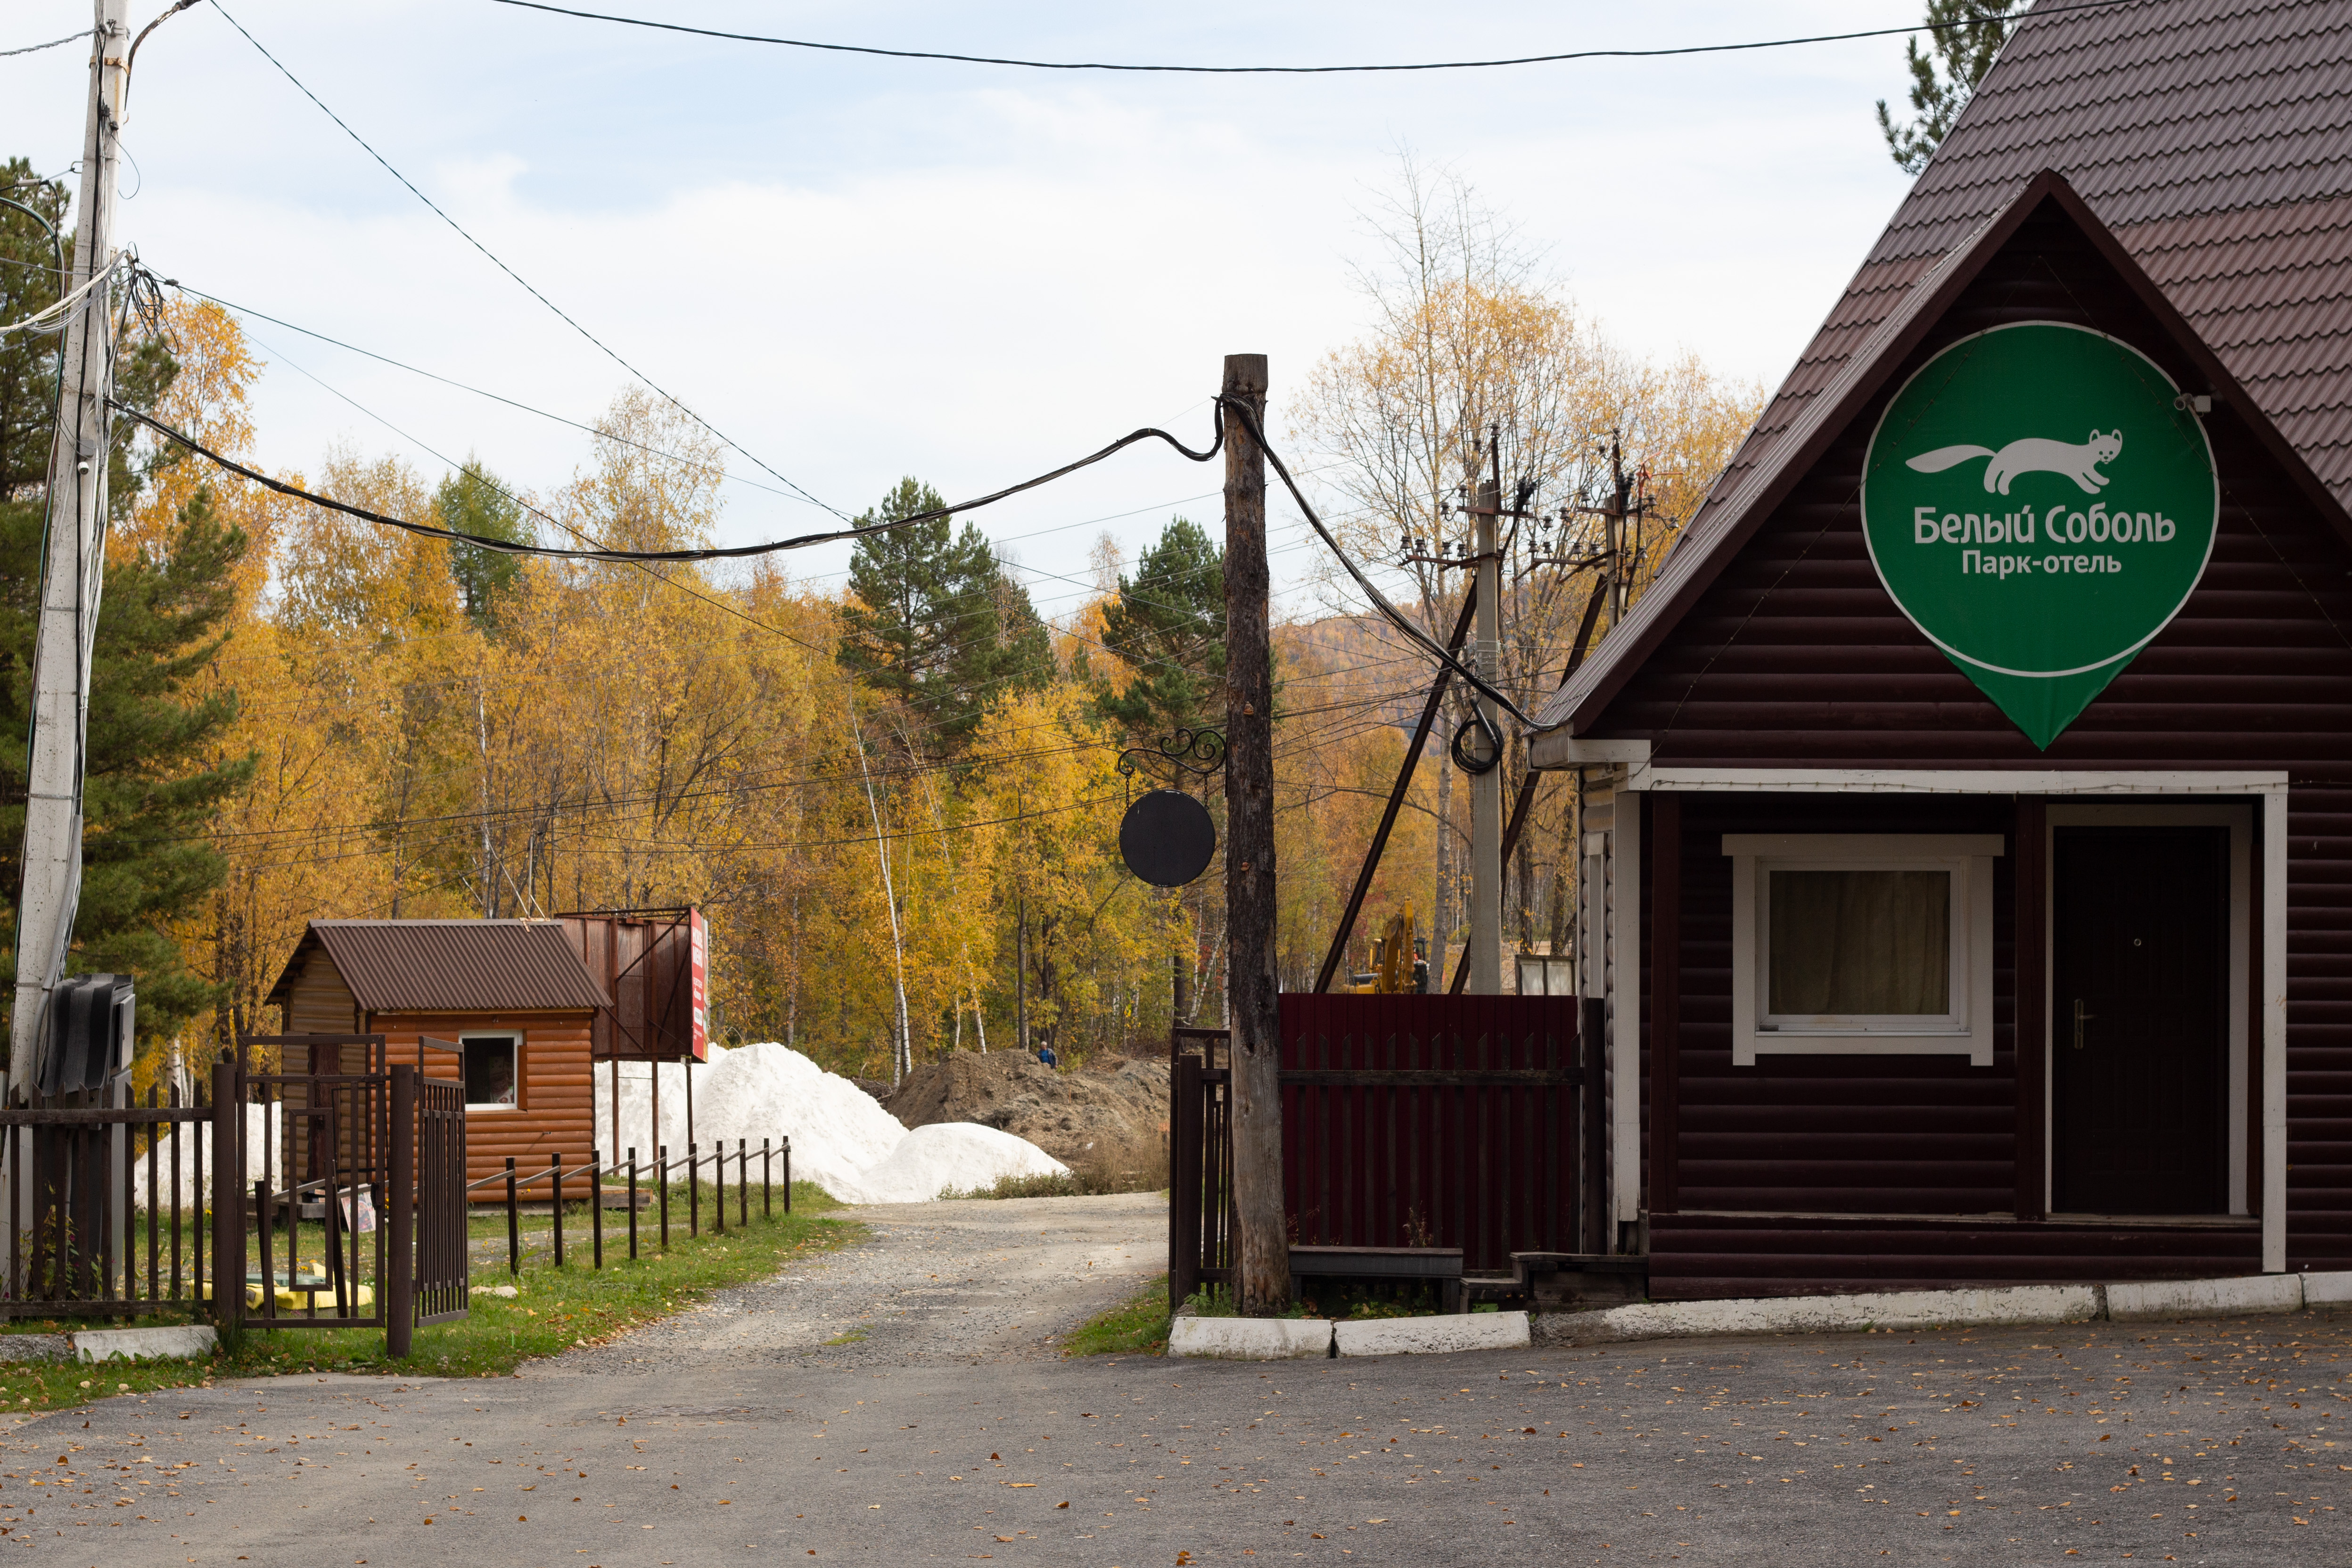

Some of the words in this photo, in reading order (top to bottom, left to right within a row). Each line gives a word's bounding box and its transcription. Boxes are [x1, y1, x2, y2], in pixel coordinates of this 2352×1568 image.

[1914, 505, 2035, 543] Белый
[2045, 501, 2176, 544] Соболь
[1962, 550, 2122, 580] Парк-отель
